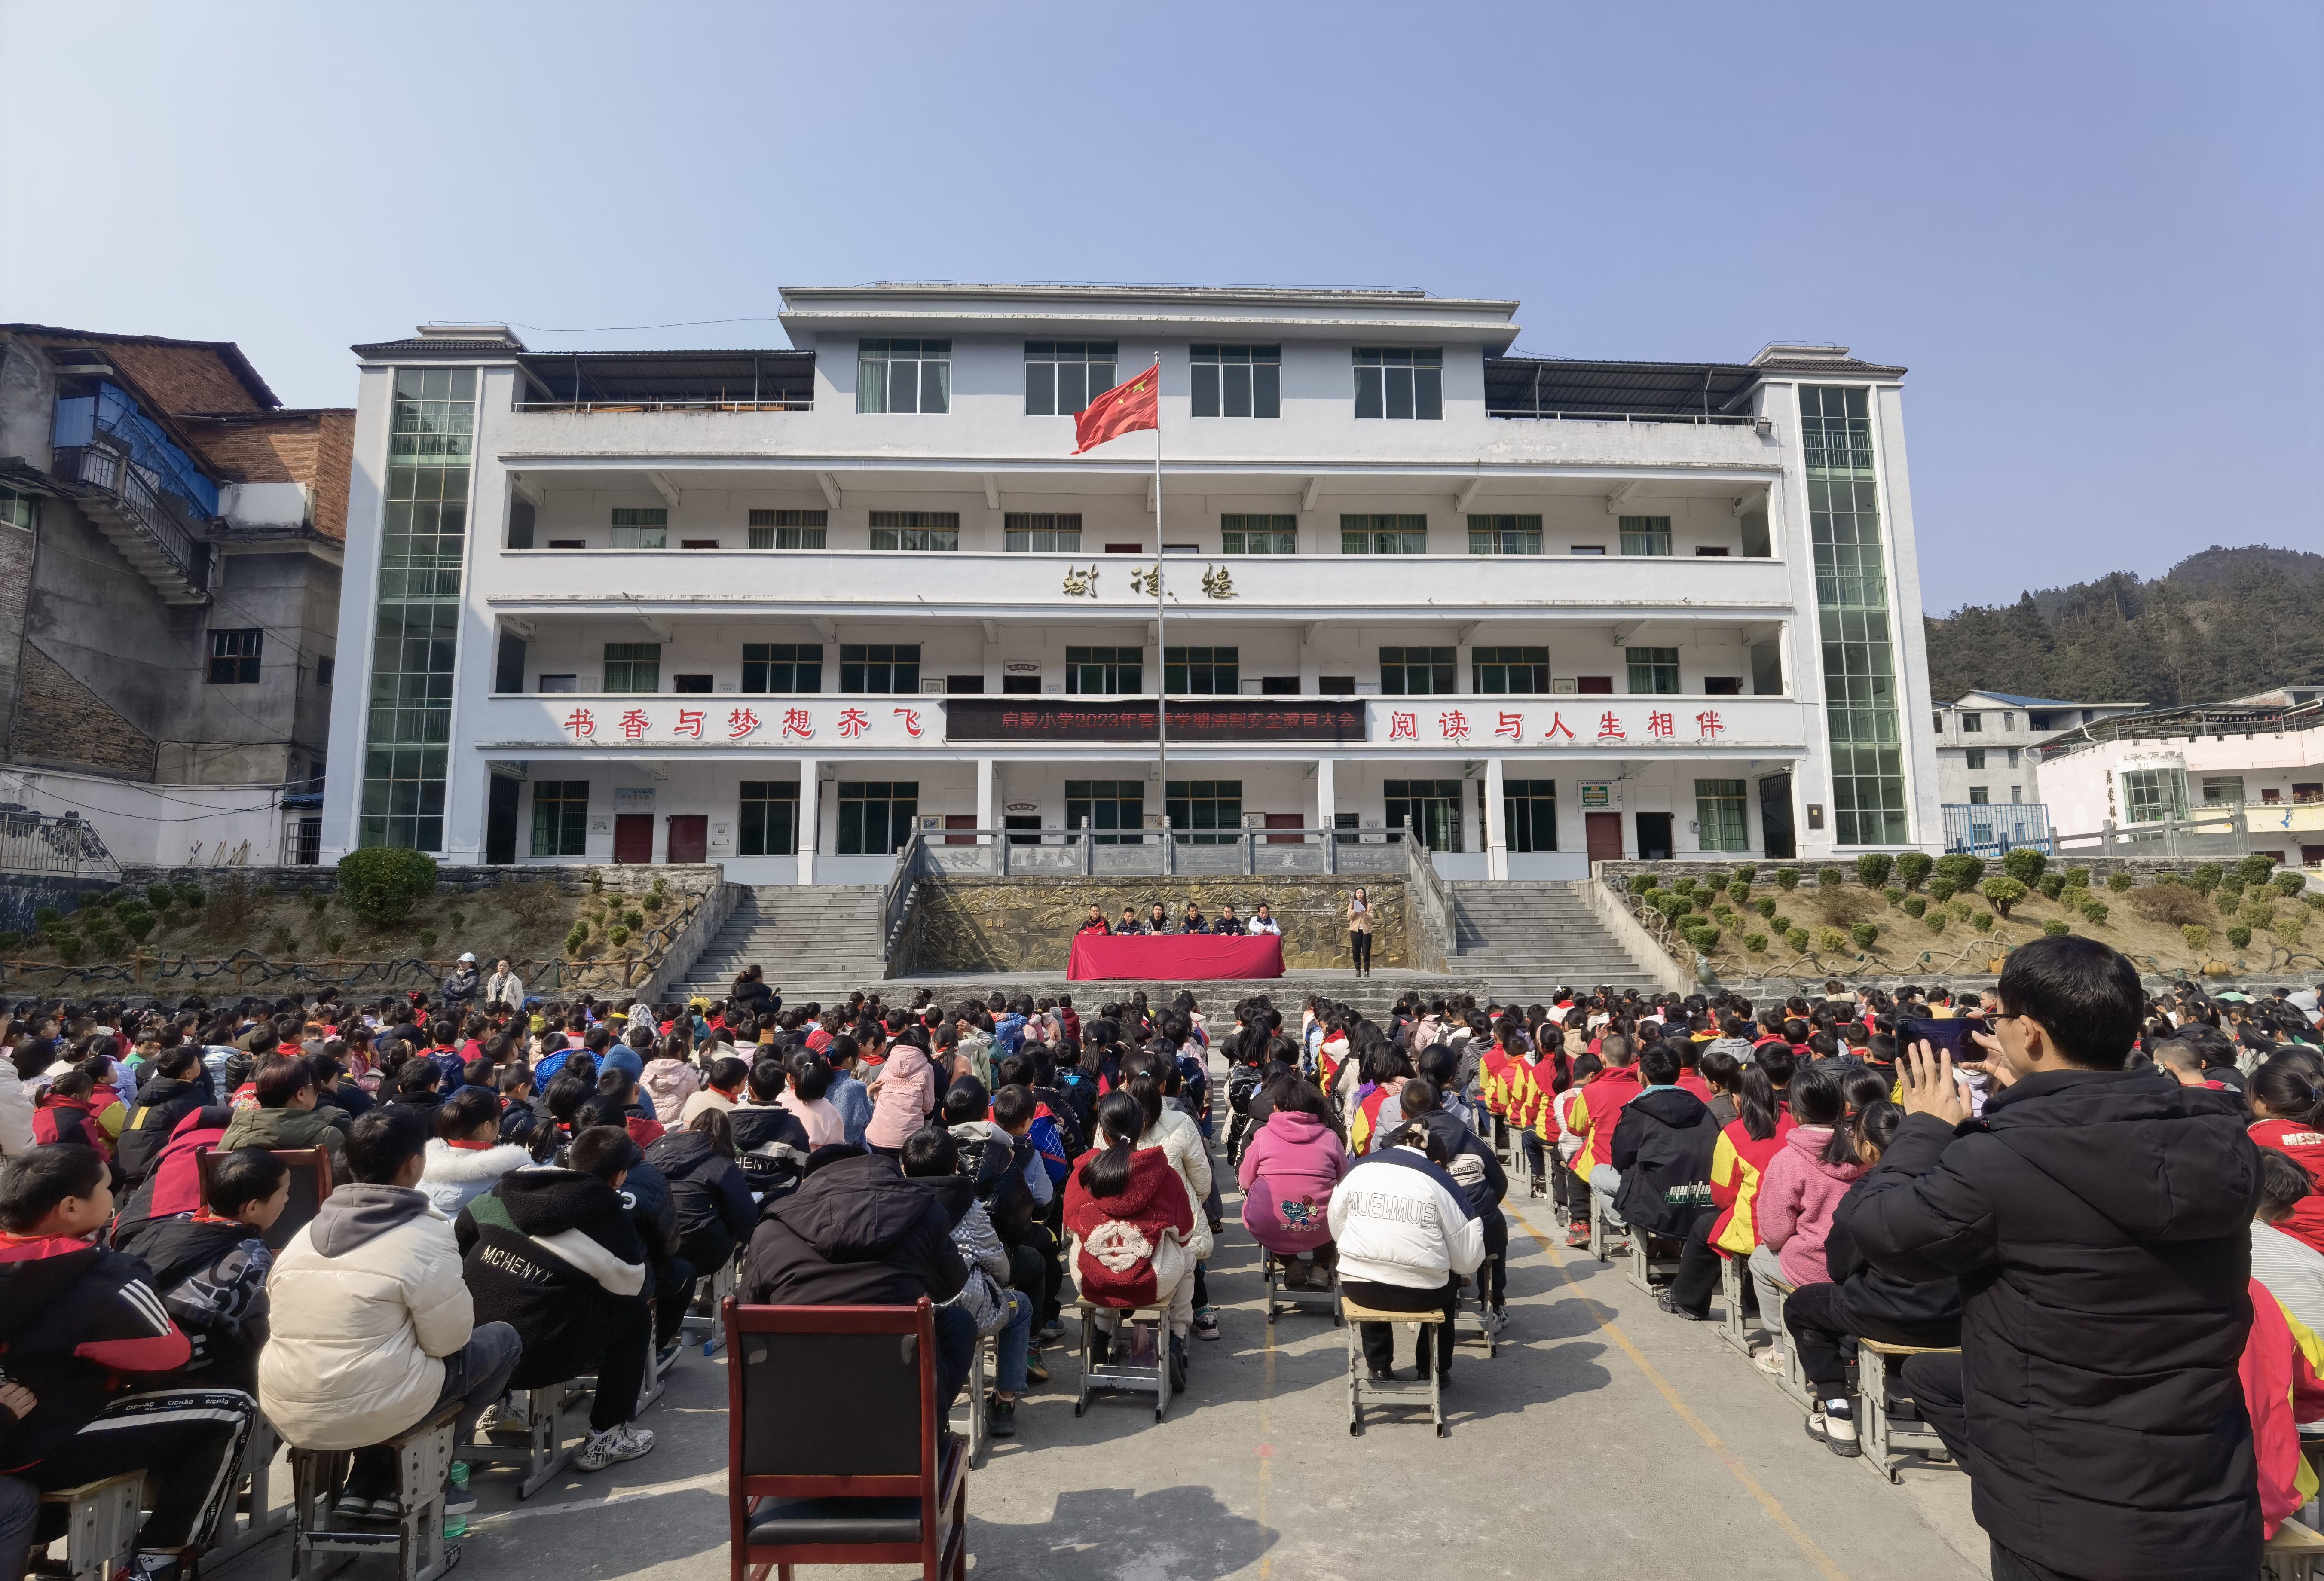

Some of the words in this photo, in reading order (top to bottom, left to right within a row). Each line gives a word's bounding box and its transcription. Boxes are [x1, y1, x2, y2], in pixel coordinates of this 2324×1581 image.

[564, 708, 923, 739] 书香与梦想齐飞
[1389, 710, 1724, 739] 阅读与人生相伴
[1452, 1164, 1475, 1175] sports
[480, 1245, 553, 1286] MCHENYX
